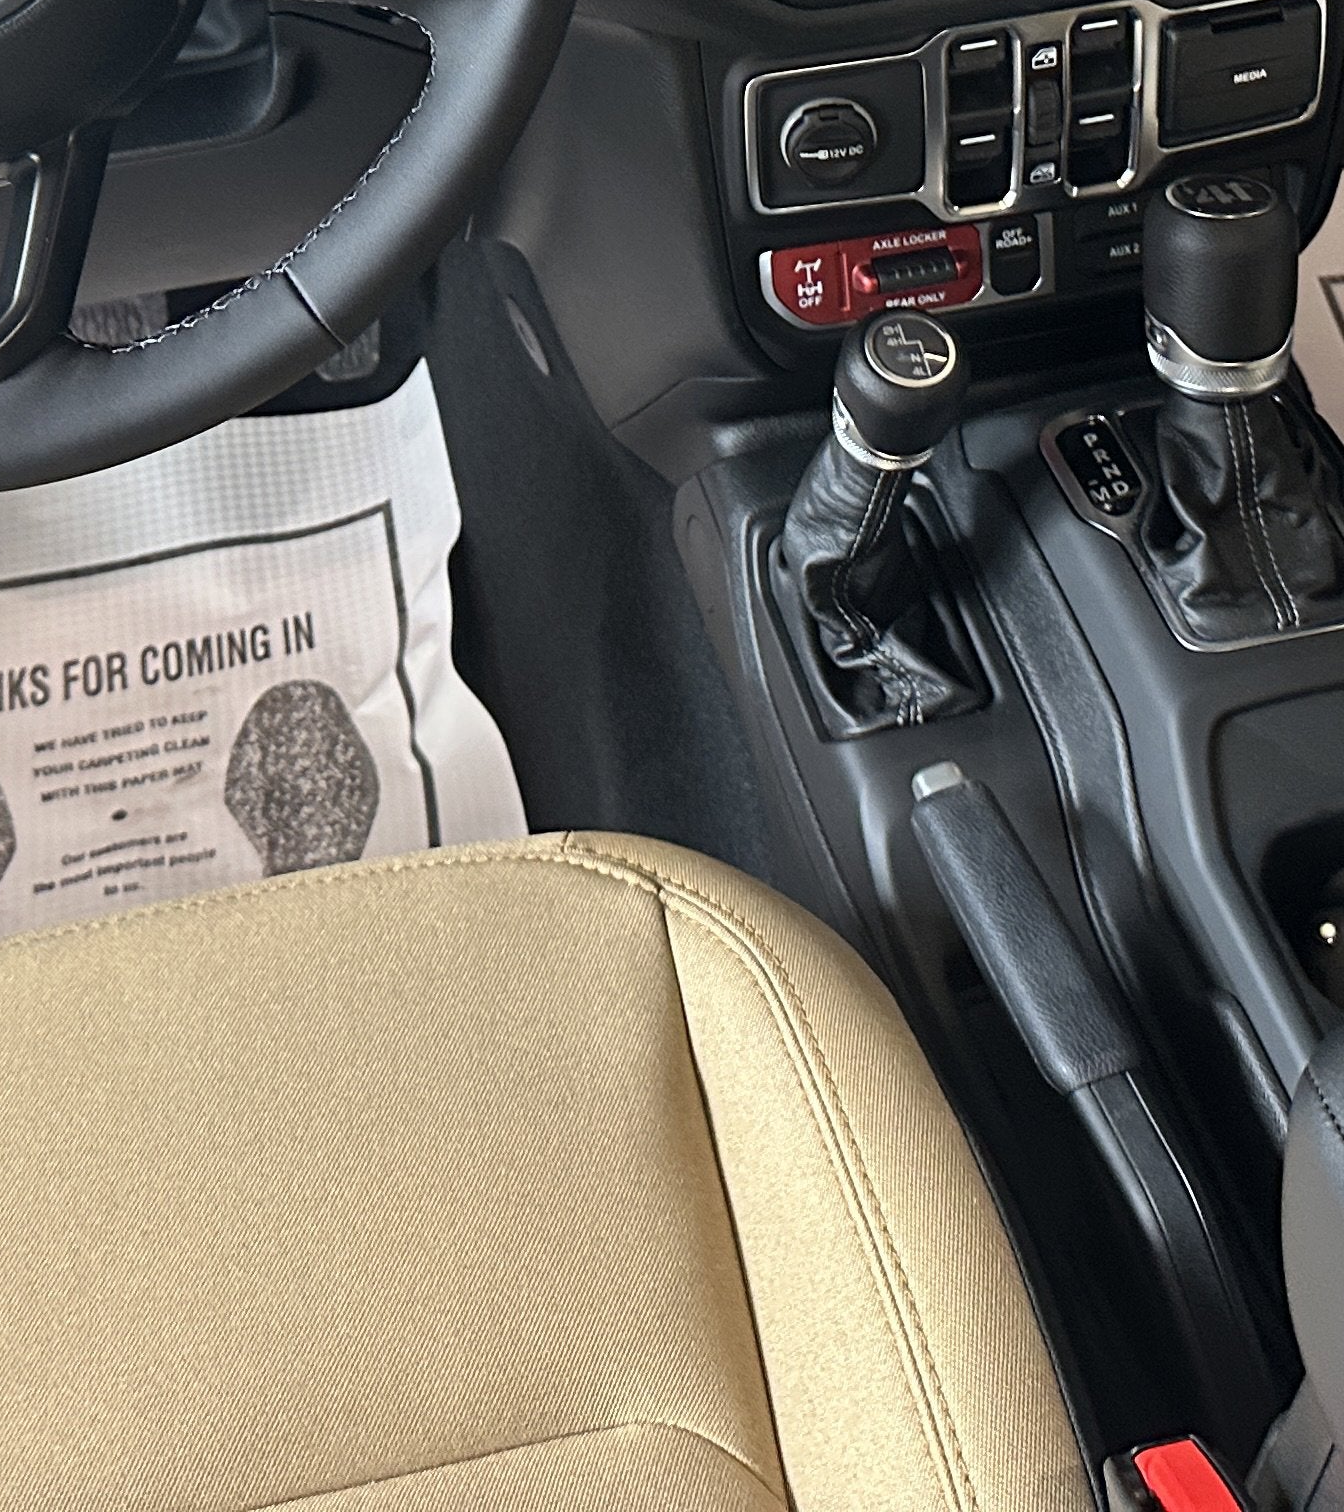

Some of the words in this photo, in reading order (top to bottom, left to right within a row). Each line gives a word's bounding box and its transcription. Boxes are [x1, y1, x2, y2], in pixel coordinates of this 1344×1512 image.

[1232, 68, 1268, 85] MEDIA
[829, 148, 847, 161] 12V
[848, 144, 865, 158] DC
[1107, 203, 1131, 219] AUX
[872, 236, 902, 251] AXLE
[903, 229, 948, 247] LOCKER
[1002, 227, 1024, 240] OFF
[1109, 244, 1132, 259] AUX
[1132, 242, 1141, 255] 2
[798, 295, 823, 310] OFF
[917, 290, 947, 305] ONLY
[909, 352, 921, 363] N
[1083, 433, 1098, 448] P
[1092, 449, 1111, 464] R
[1102, 465, 1122, 480] N
[1089, 486, 1111, 504] M
[1112, 479, 1130, 497] D
[61, 649, 130, 701] FOR
[140, 622, 274, 688] COMING
[282, 610, 317, 657] IN
[34, 739, 56, 754] WE
[60, 731, 98, 749] HAVE
[101, 721, 146, 741] TRIED
[149, 716, 169, 730] TO
[171, 709, 209, 726] KEEP
[32, 761, 74, 778] YOUR
[77, 742, 160, 772] CARPETING
[163, 734, 211, 754] CLEAN
[40, 784, 81, 804] WITH
[83, 780, 118, 796] THIS
[121, 768, 170, 789] PAPER
[172, 760, 204, 778] MAT
